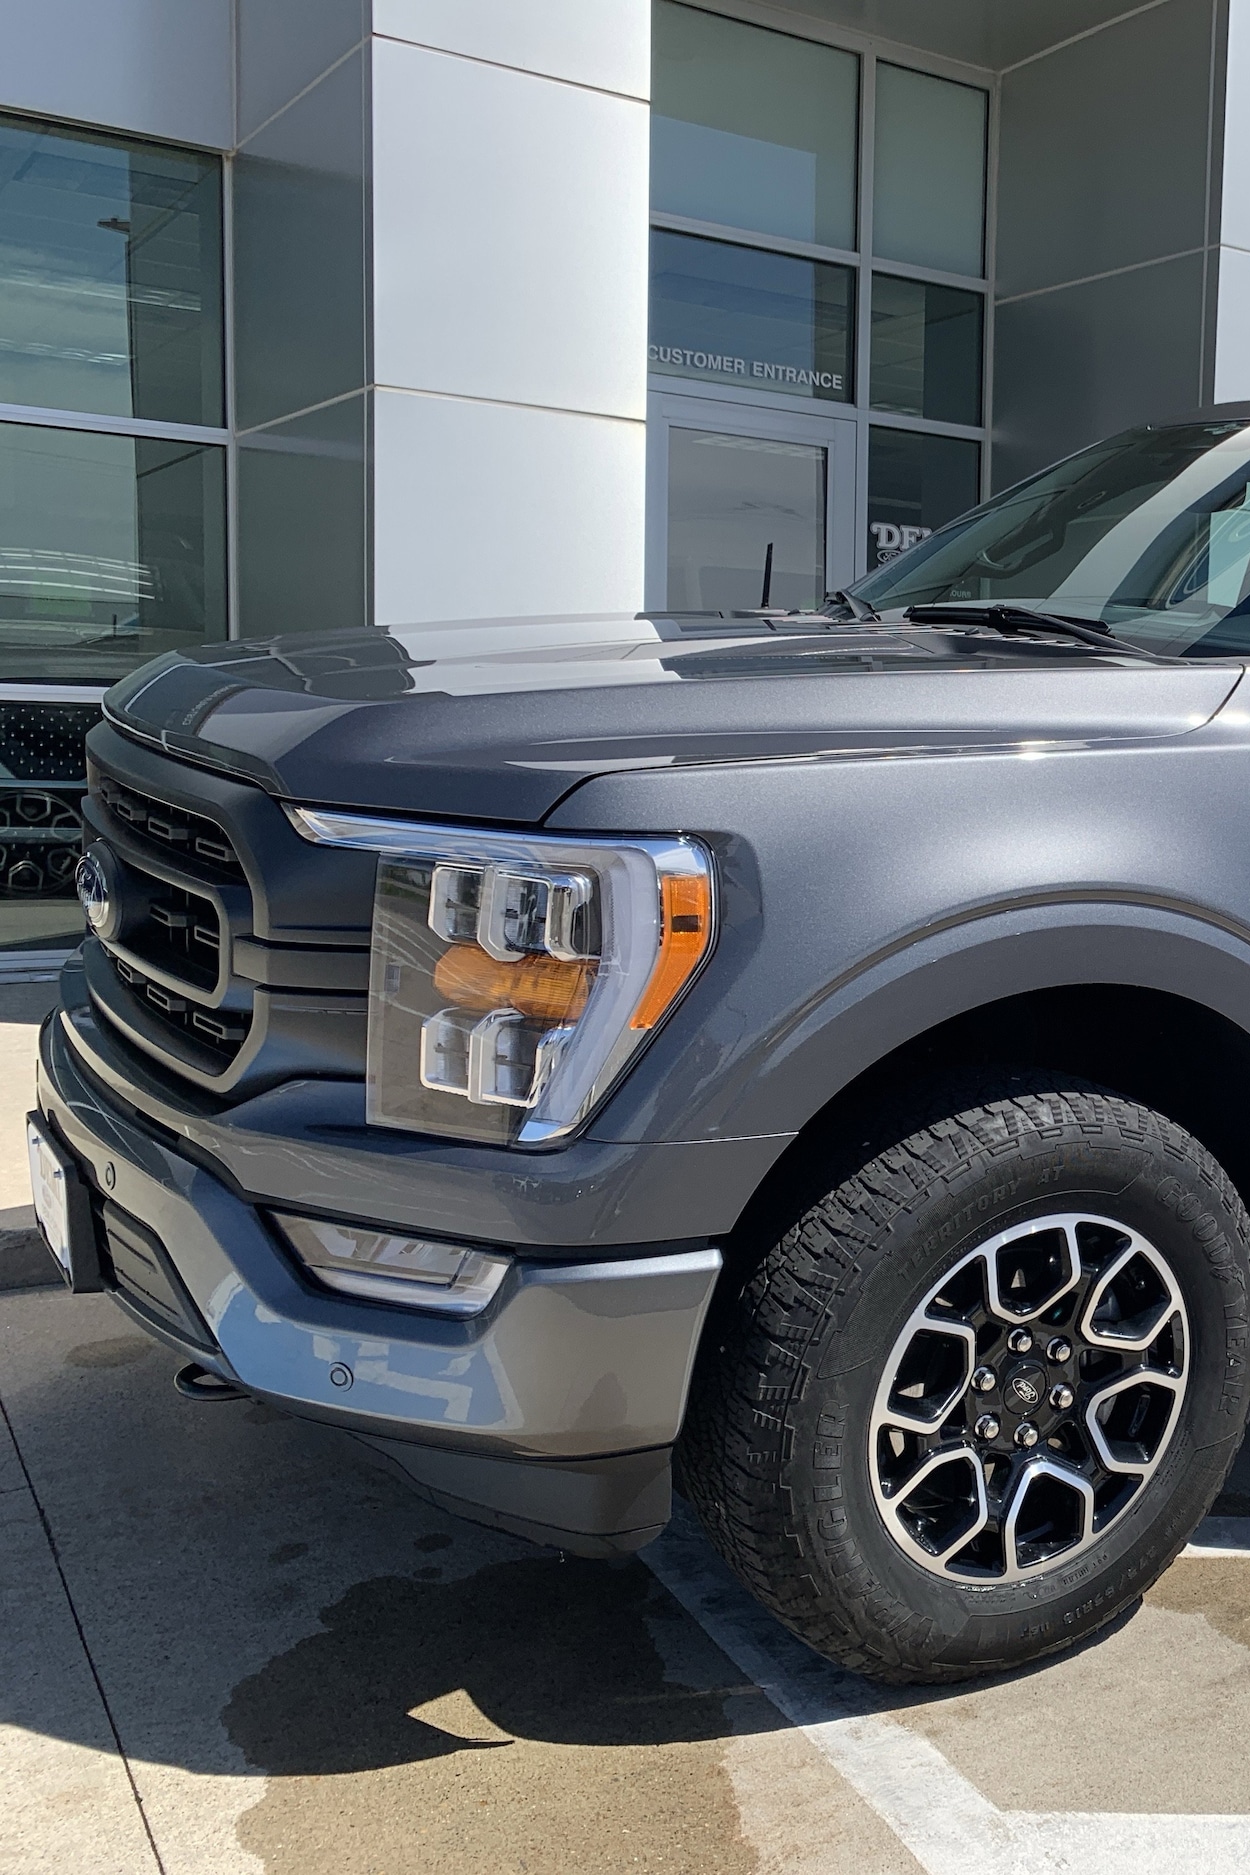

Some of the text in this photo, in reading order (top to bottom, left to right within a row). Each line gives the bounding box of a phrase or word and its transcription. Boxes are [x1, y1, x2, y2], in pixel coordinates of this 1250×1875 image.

[647, 344, 844, 390] CUSTOMER ENTRANCE
[870, 521, 933, 552] DE
[904, 1165, 1065, 1278] TERRITORY AT
[1016, 1381, 1036, 1401] Ford
[811, 1399, 937, 1650] WRANGLER
